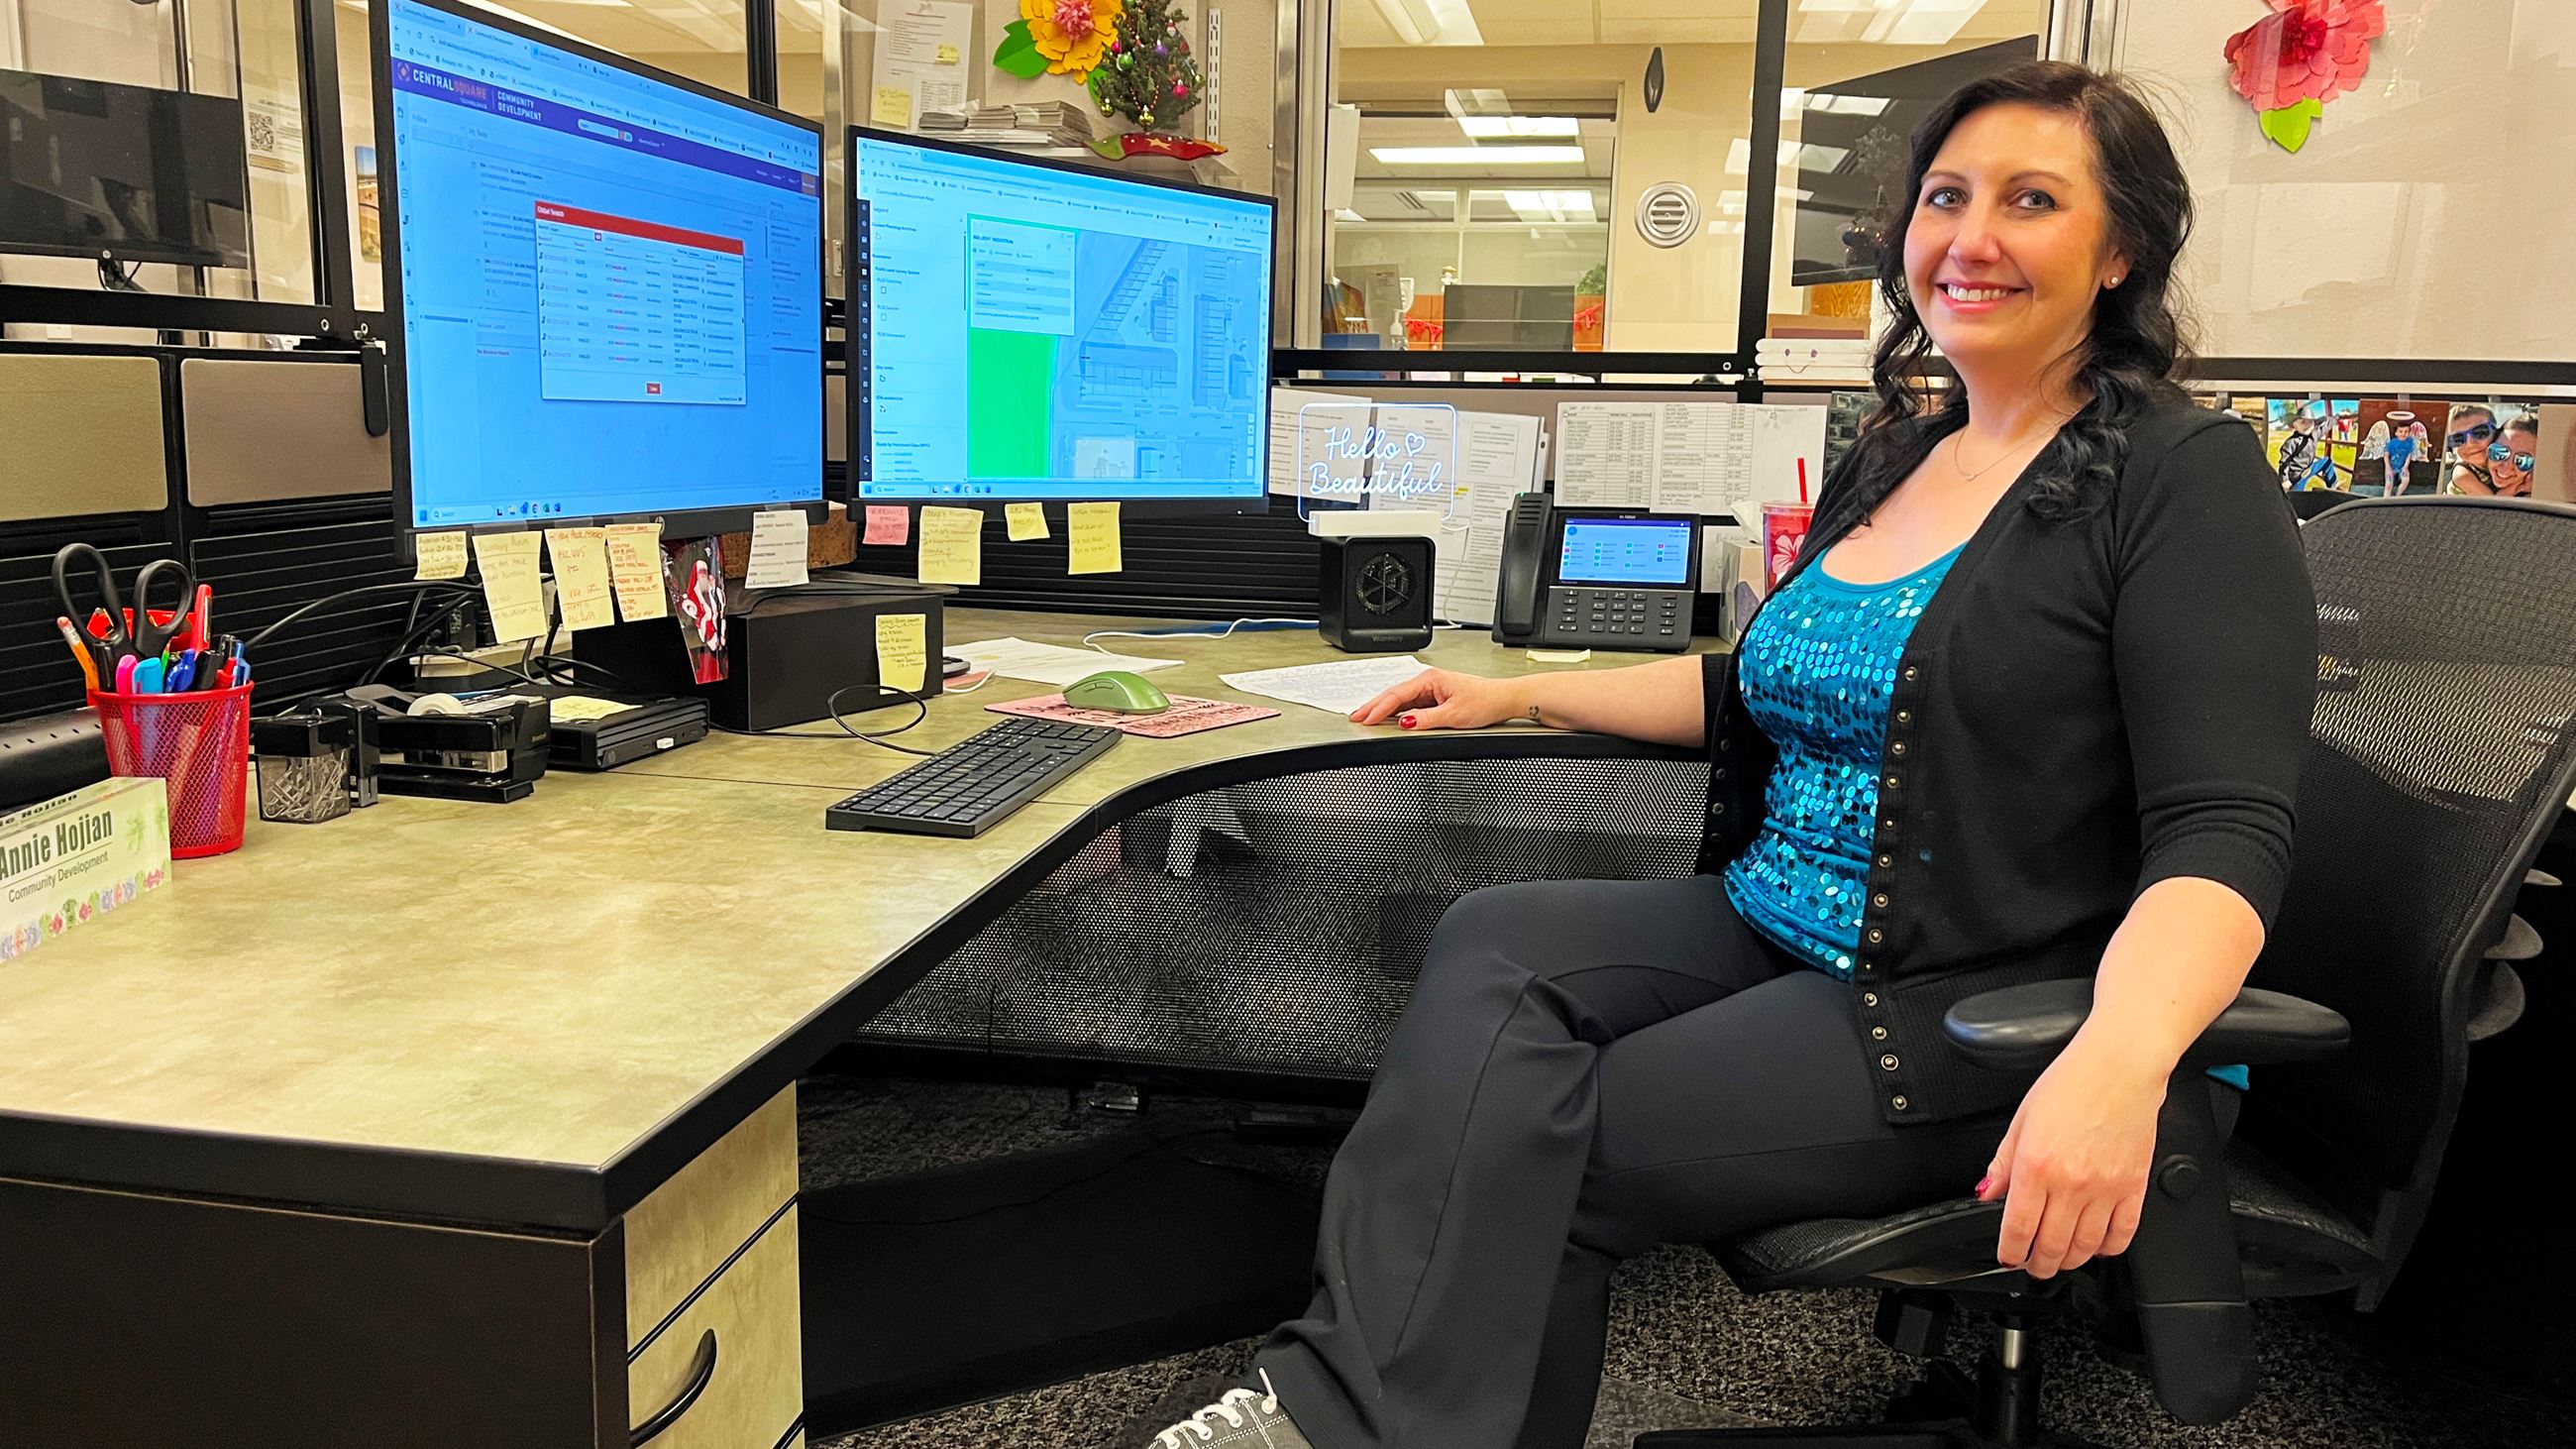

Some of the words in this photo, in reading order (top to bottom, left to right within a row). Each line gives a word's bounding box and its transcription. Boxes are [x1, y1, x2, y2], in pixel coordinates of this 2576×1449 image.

[497, 90, 535, 109] COMMUNITY
[497, 102, 542, 122] DEVELOPMENT
[1324, 424, 1402, 461] Hello
[1308, 460, 1444, 501] Beautiful
[0, 833, 52, 881] Annie
[54, 810, 113, 857] Hojian
[8, 873, 57, 903] Community
[57, 850, 109, 882] Development
